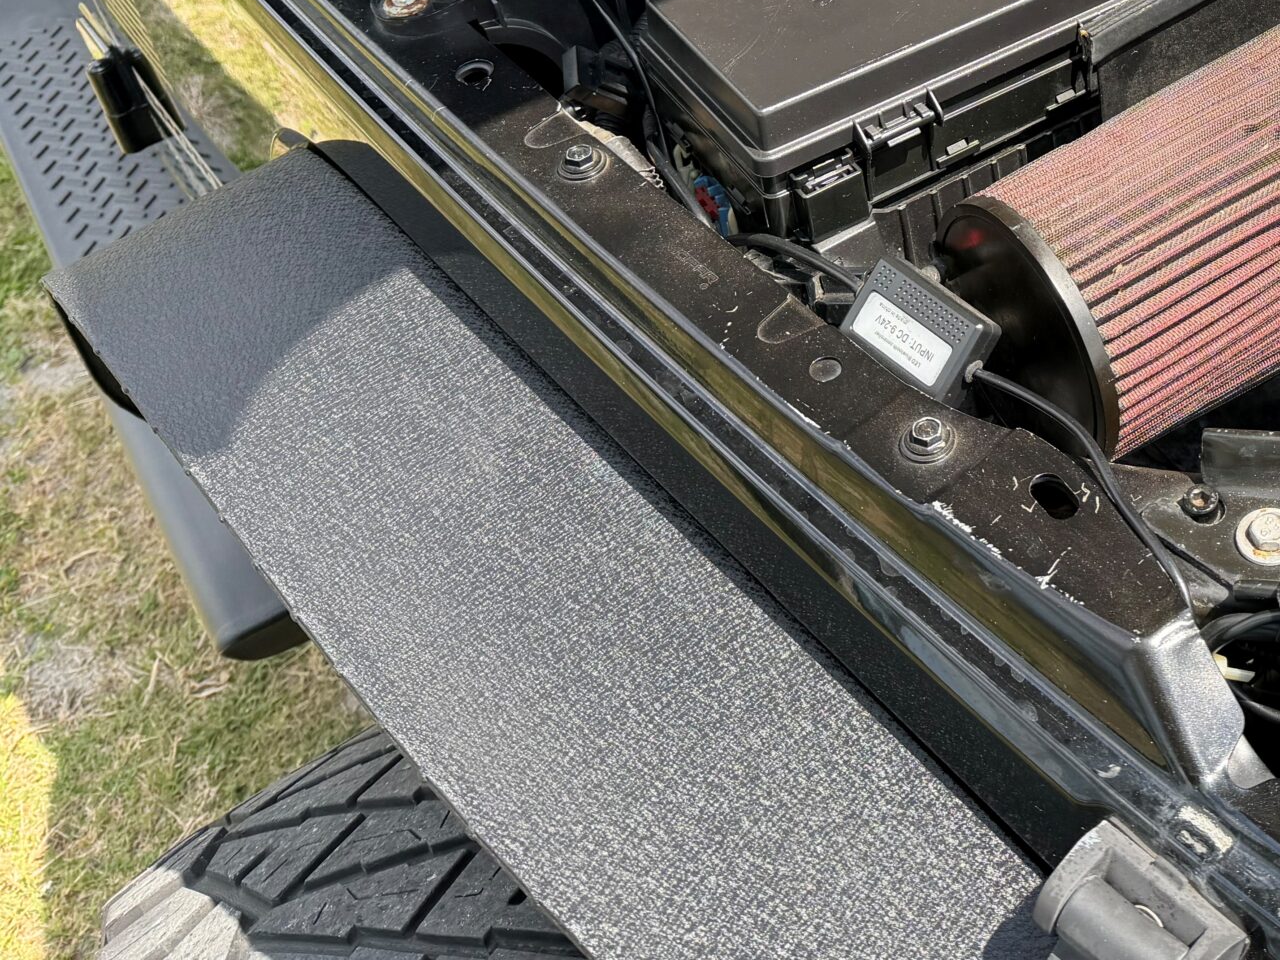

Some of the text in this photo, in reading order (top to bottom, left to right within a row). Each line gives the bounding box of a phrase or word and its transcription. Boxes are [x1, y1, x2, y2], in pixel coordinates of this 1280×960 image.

[874, 313, 935, 362] INPUT: DC 9-24V
